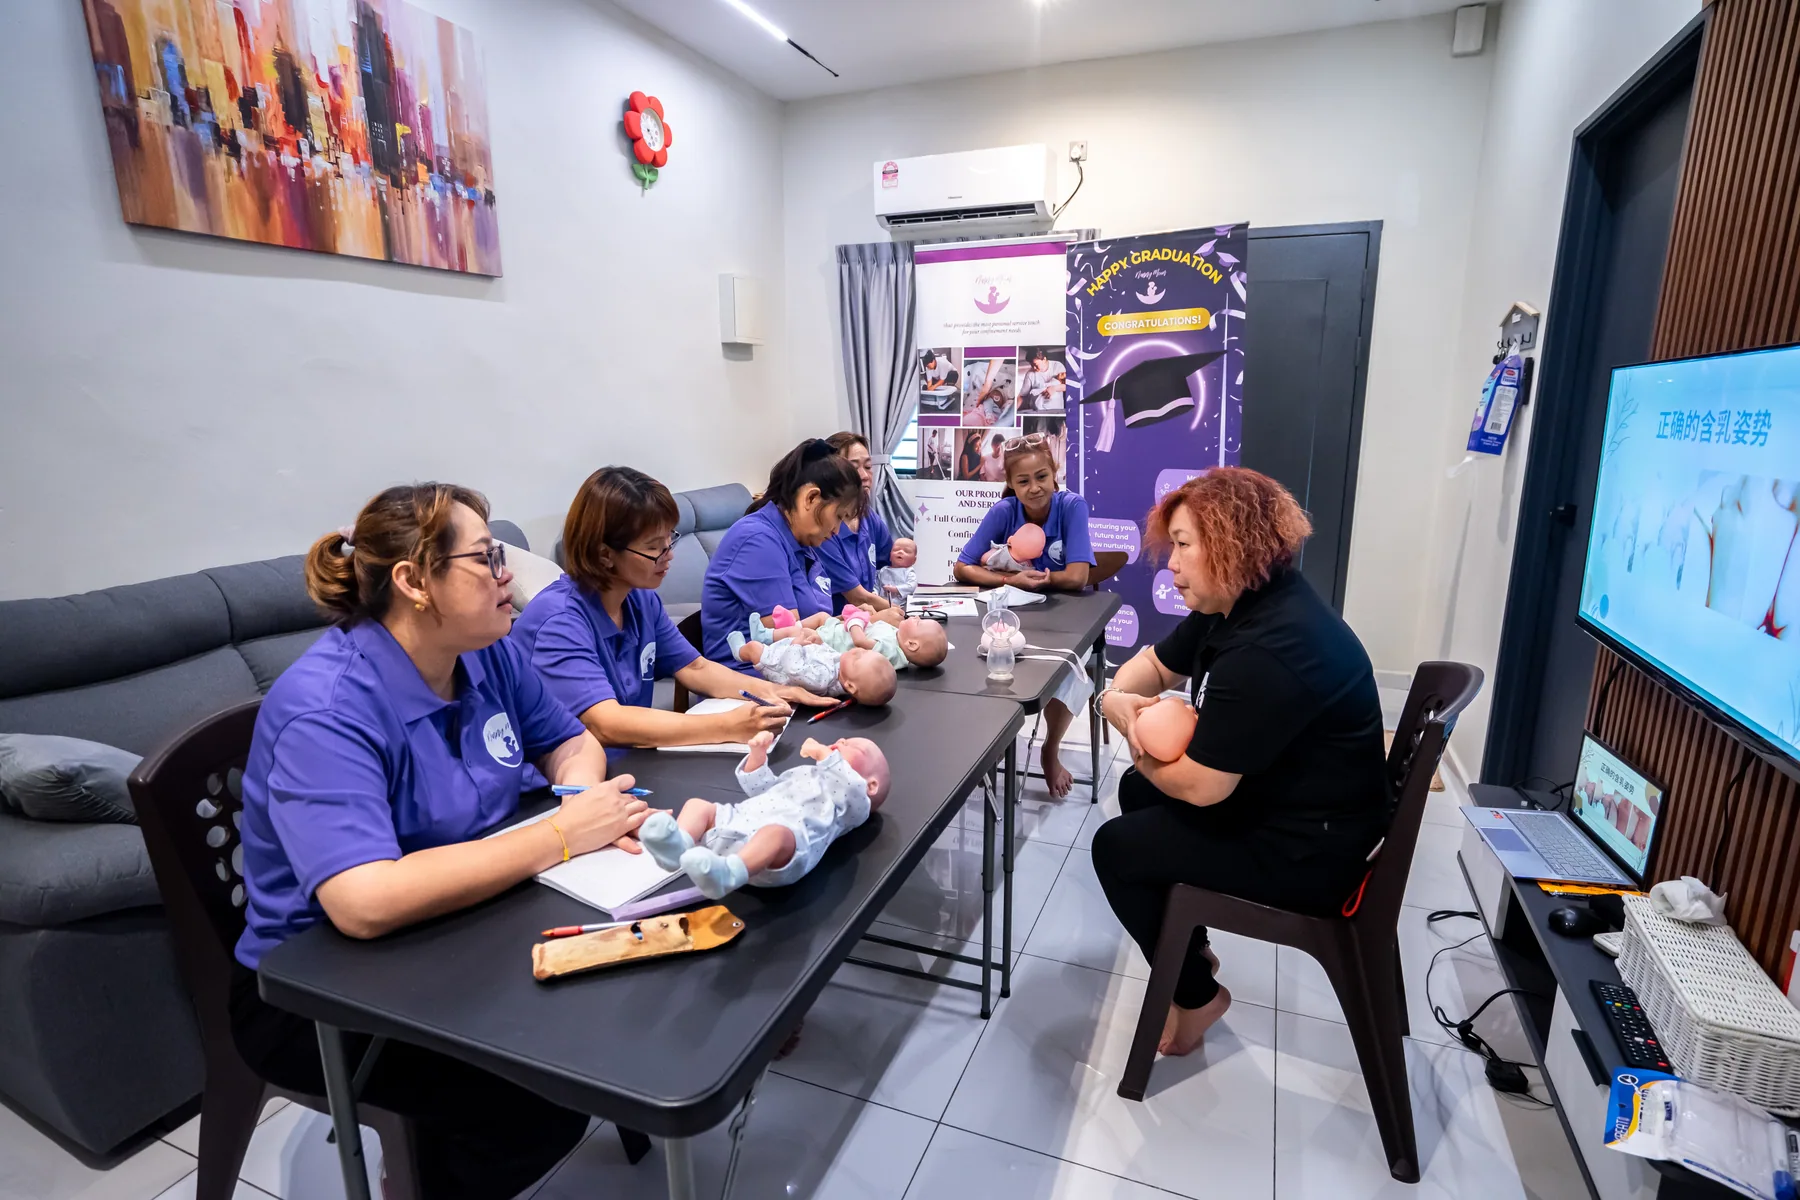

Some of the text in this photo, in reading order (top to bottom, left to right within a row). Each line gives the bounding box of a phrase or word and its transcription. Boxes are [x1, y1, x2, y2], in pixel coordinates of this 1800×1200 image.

[1086, 248, 1223, 297] HAPPY GRADUATION
[1103, 314, 1202, 331] CONGRATULATIONS!
[1656, 409, 1772, 447] 正确的含乳姿势
[955, 489, 975, 498] OUR
[958, 500, 977, 508] AND
[934, 514, 984, 524] Full Confine
[1088, 522, 1120, 532] Nurturing
[1094, 531, 1115, 539] future
[1103, 542, 1136, 552] nurturing
[1112, 625, 1123, 633] for
